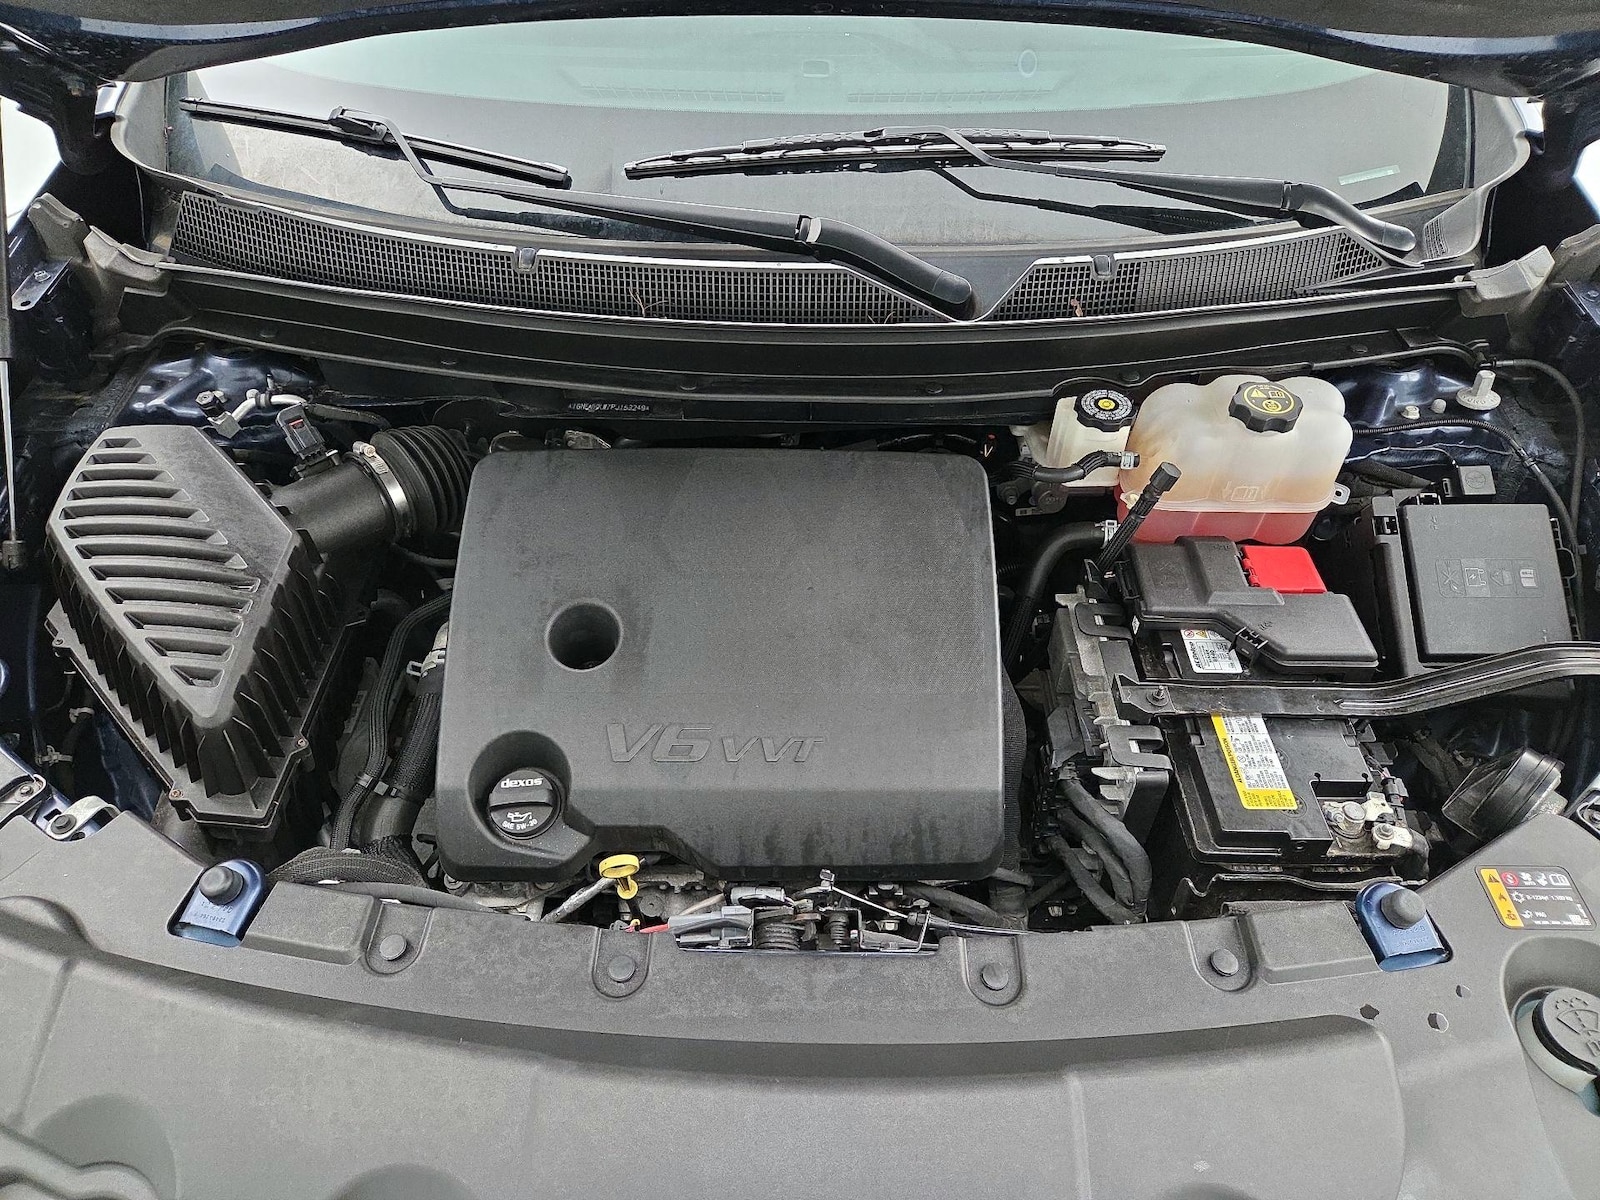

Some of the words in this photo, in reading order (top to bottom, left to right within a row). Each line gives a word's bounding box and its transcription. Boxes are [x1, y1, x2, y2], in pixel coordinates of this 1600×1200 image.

[606, 723, 714, 762] V6
[721, 736, 824, 762] VVT
[500, 777, 543, 788] dexos
